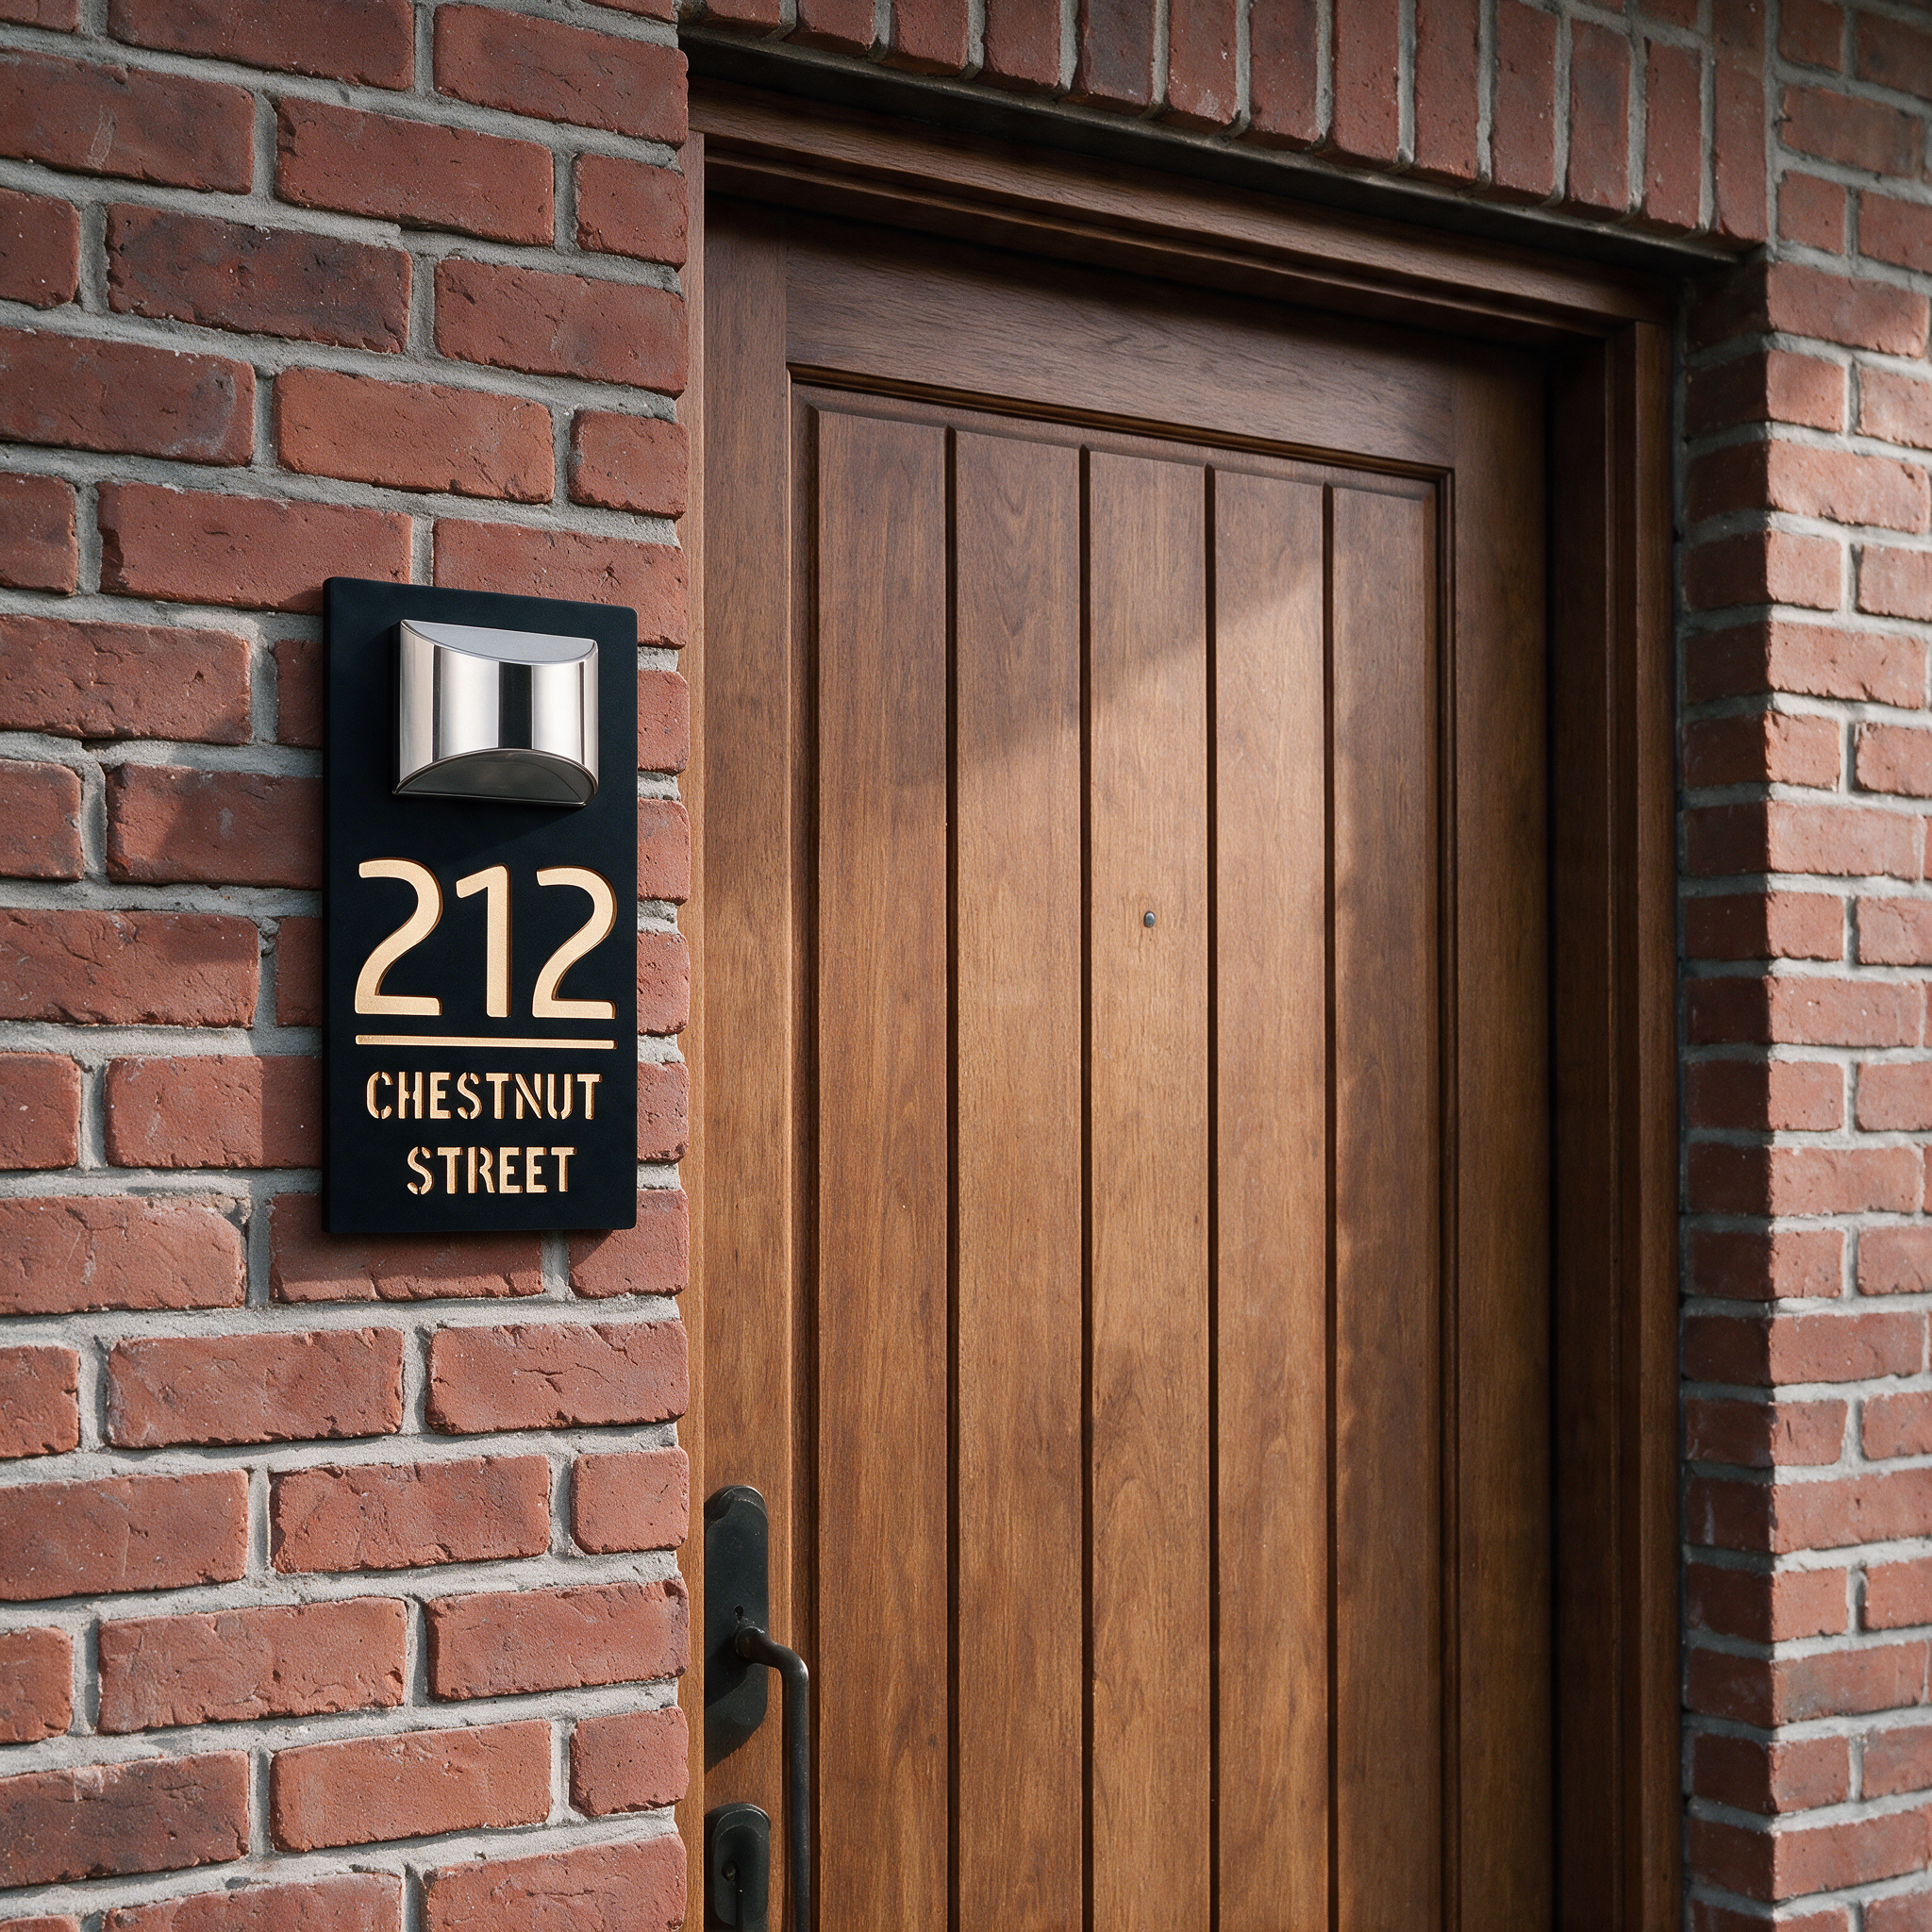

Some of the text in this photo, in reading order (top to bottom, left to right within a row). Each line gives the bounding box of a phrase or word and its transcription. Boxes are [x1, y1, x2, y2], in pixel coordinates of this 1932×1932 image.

[354, 858, 615, 1020] 212
[365, 1071, 601, 1121] CHESTNUT
[407, 1146, 575, 1195] STREET
